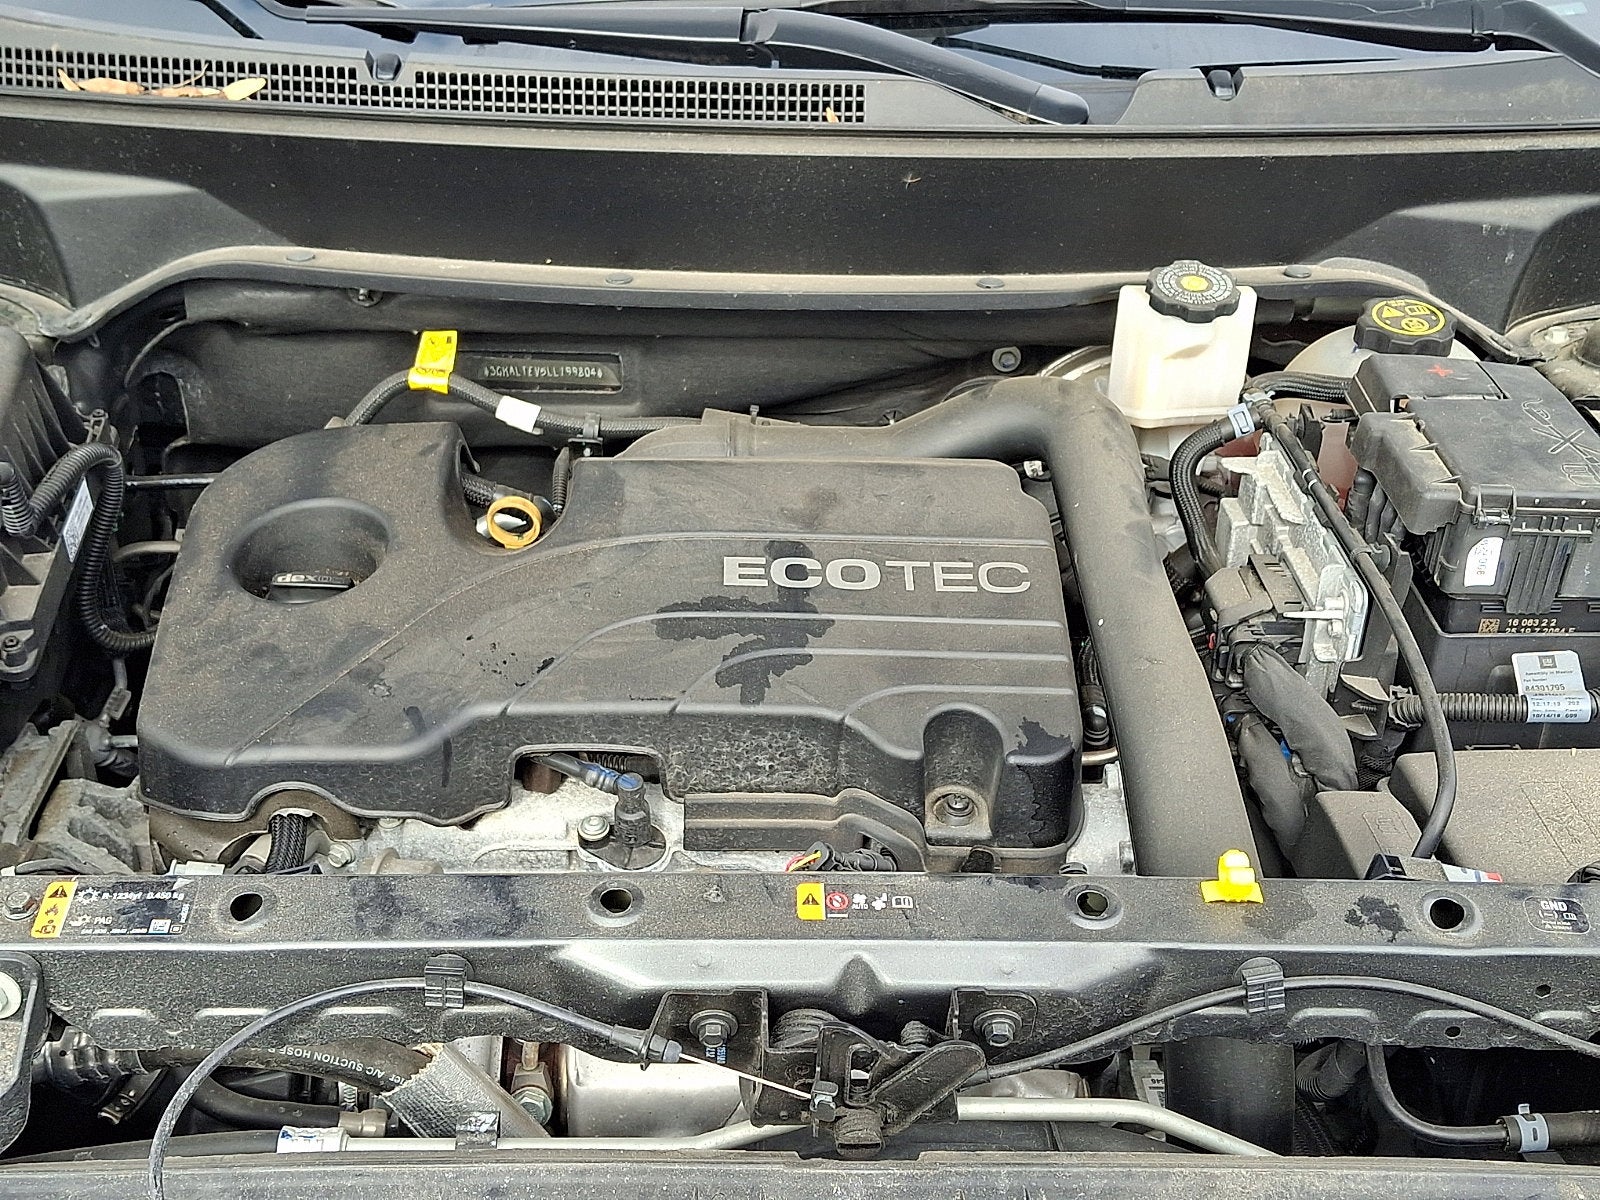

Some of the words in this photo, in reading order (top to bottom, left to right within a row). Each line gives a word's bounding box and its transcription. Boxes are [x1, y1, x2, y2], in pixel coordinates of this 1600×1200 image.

[723, 556, 1031, 594] ECOTEC
[1540, 900, 1568, 912] GND
[93, 916, 113, 925] PAG
[279, 1048, 312, 1058] HOSE
[313, 1051, 366, 1072] SUCTION
[365, 1066, 386, 1078] A/C
